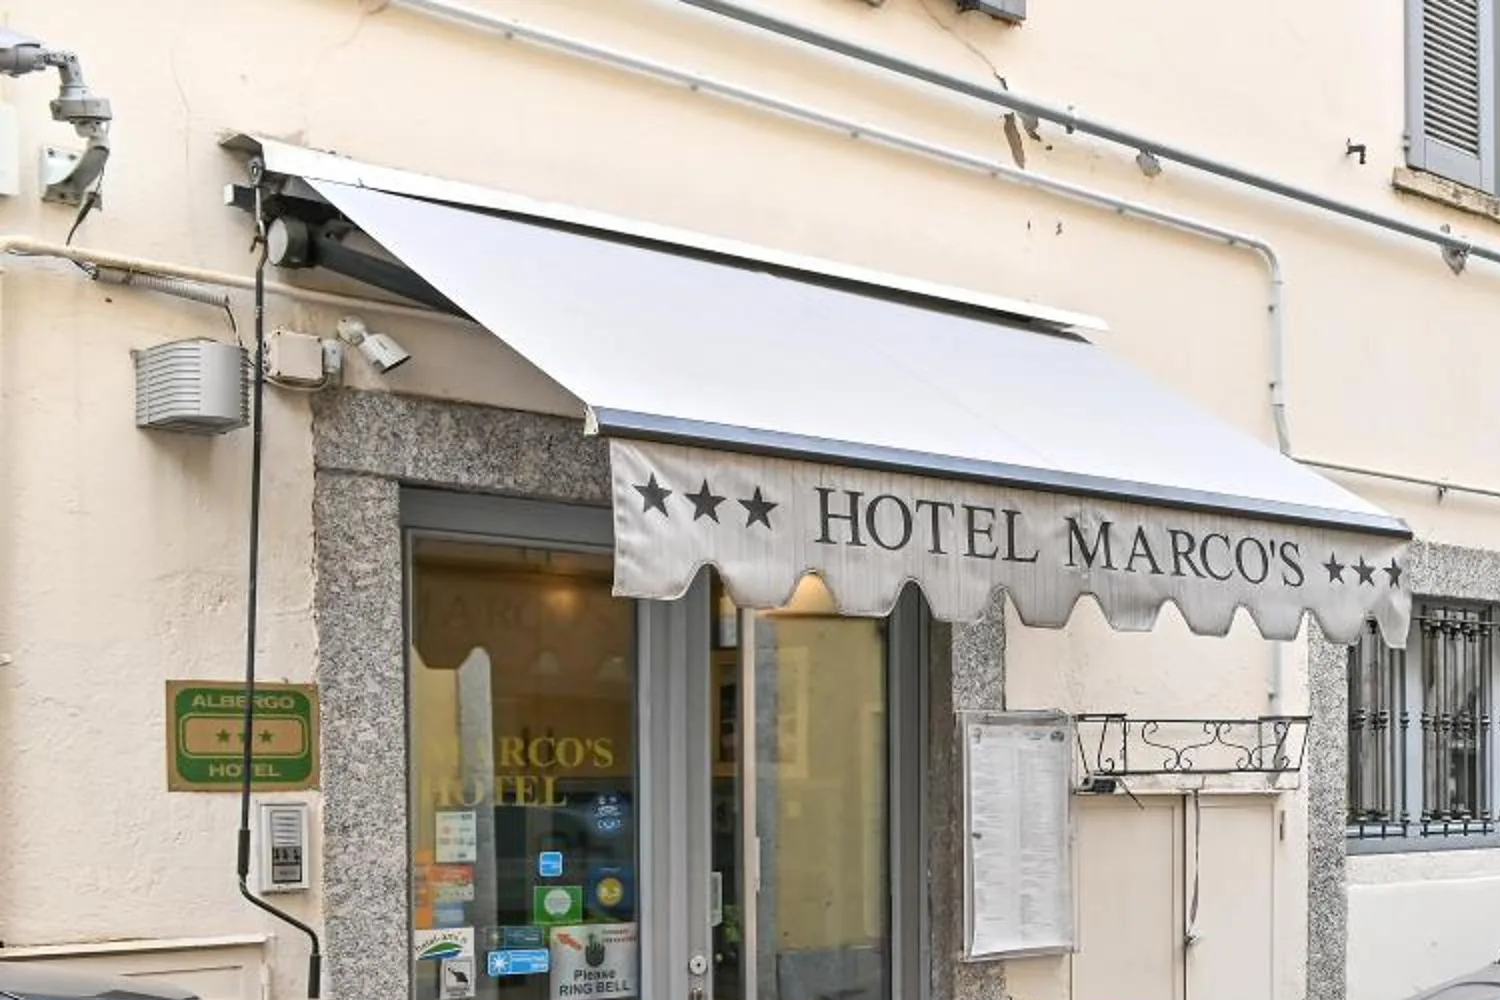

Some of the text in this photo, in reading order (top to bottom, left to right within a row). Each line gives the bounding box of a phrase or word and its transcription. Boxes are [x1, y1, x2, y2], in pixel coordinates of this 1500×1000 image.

[814, 486, 1305, 587] HOTEL MARCO'S
[191, 694, 295, 709] ALBERGO
[208, 763, 281, 777] HOEL
[559, 980, 632, 996] RING BELL
